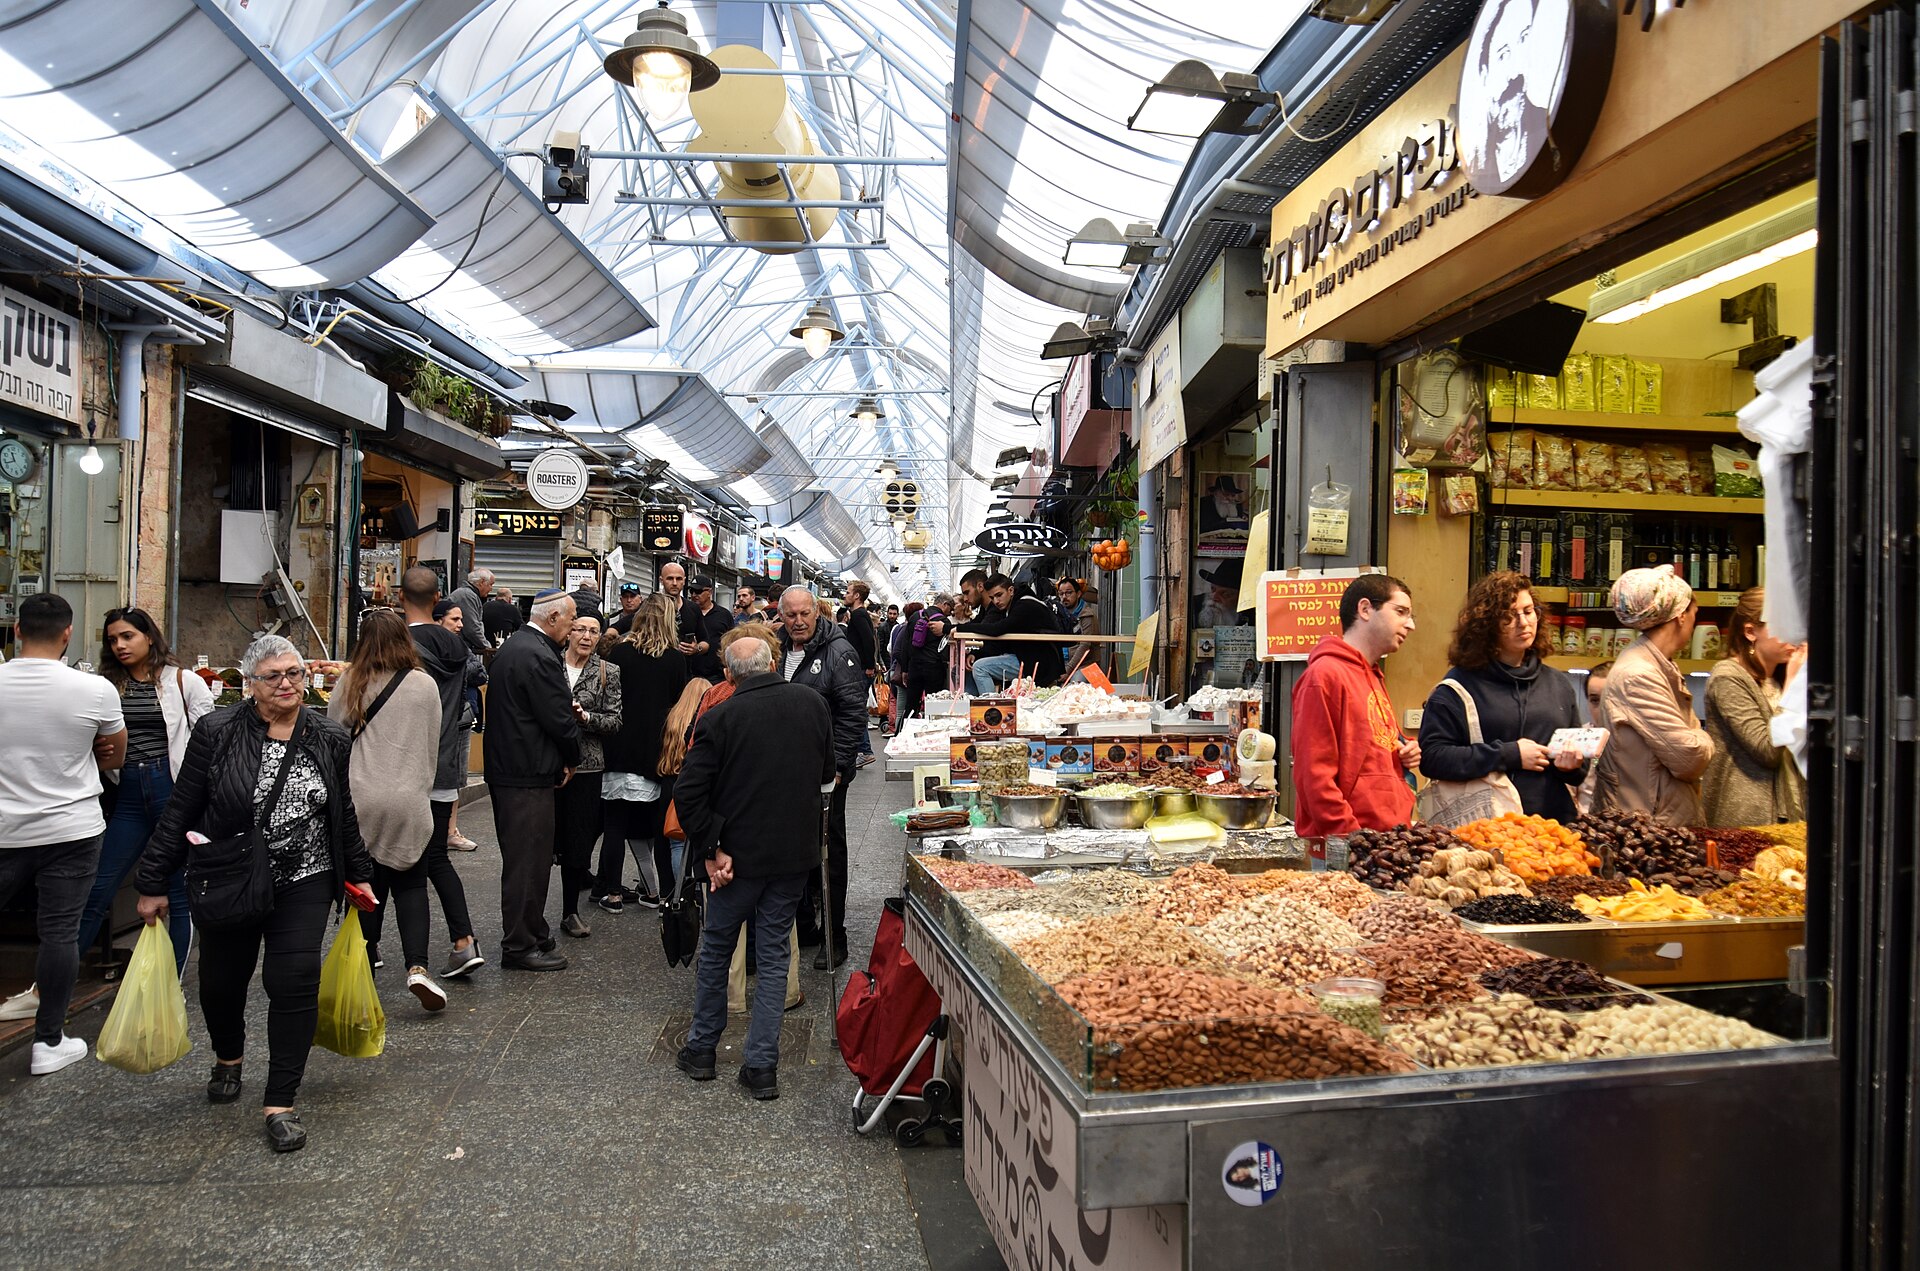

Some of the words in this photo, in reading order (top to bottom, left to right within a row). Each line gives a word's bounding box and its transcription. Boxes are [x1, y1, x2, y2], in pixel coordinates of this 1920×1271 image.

[1262, 186, 1349, 294] מזרחי
[1380, 213, 1424, 258] קטניות
[1337, 243, 1379, 285] תבלינים
[1315, 271, 1336, 300] קפה
[0, 297, 72, 377] בשק
[26, 380, 44, 405] תה
[48, 388, 73, 418] קפה
[536, 472, 577, 486] ROASTERS
[498, 513, 561, 534] כנאפה
[647, 514, 680, 524] כנאפה
[1271, 582, 1317, 595] מזרחי
[1321, 581, 1351, 594] וחי
[1289, 599, 1323, 611] לפסח
[1297, 615, 1326, 626] שמח
[1267, 634, 1293, 648] חמץ
[907, 915, 935, 986] מזרחי
[936, 948, 975, 1043] אבירם
[991, 1020, 1054, 1156] פיצוחי
[967, 1080, 1020, 1240] מזרחי
